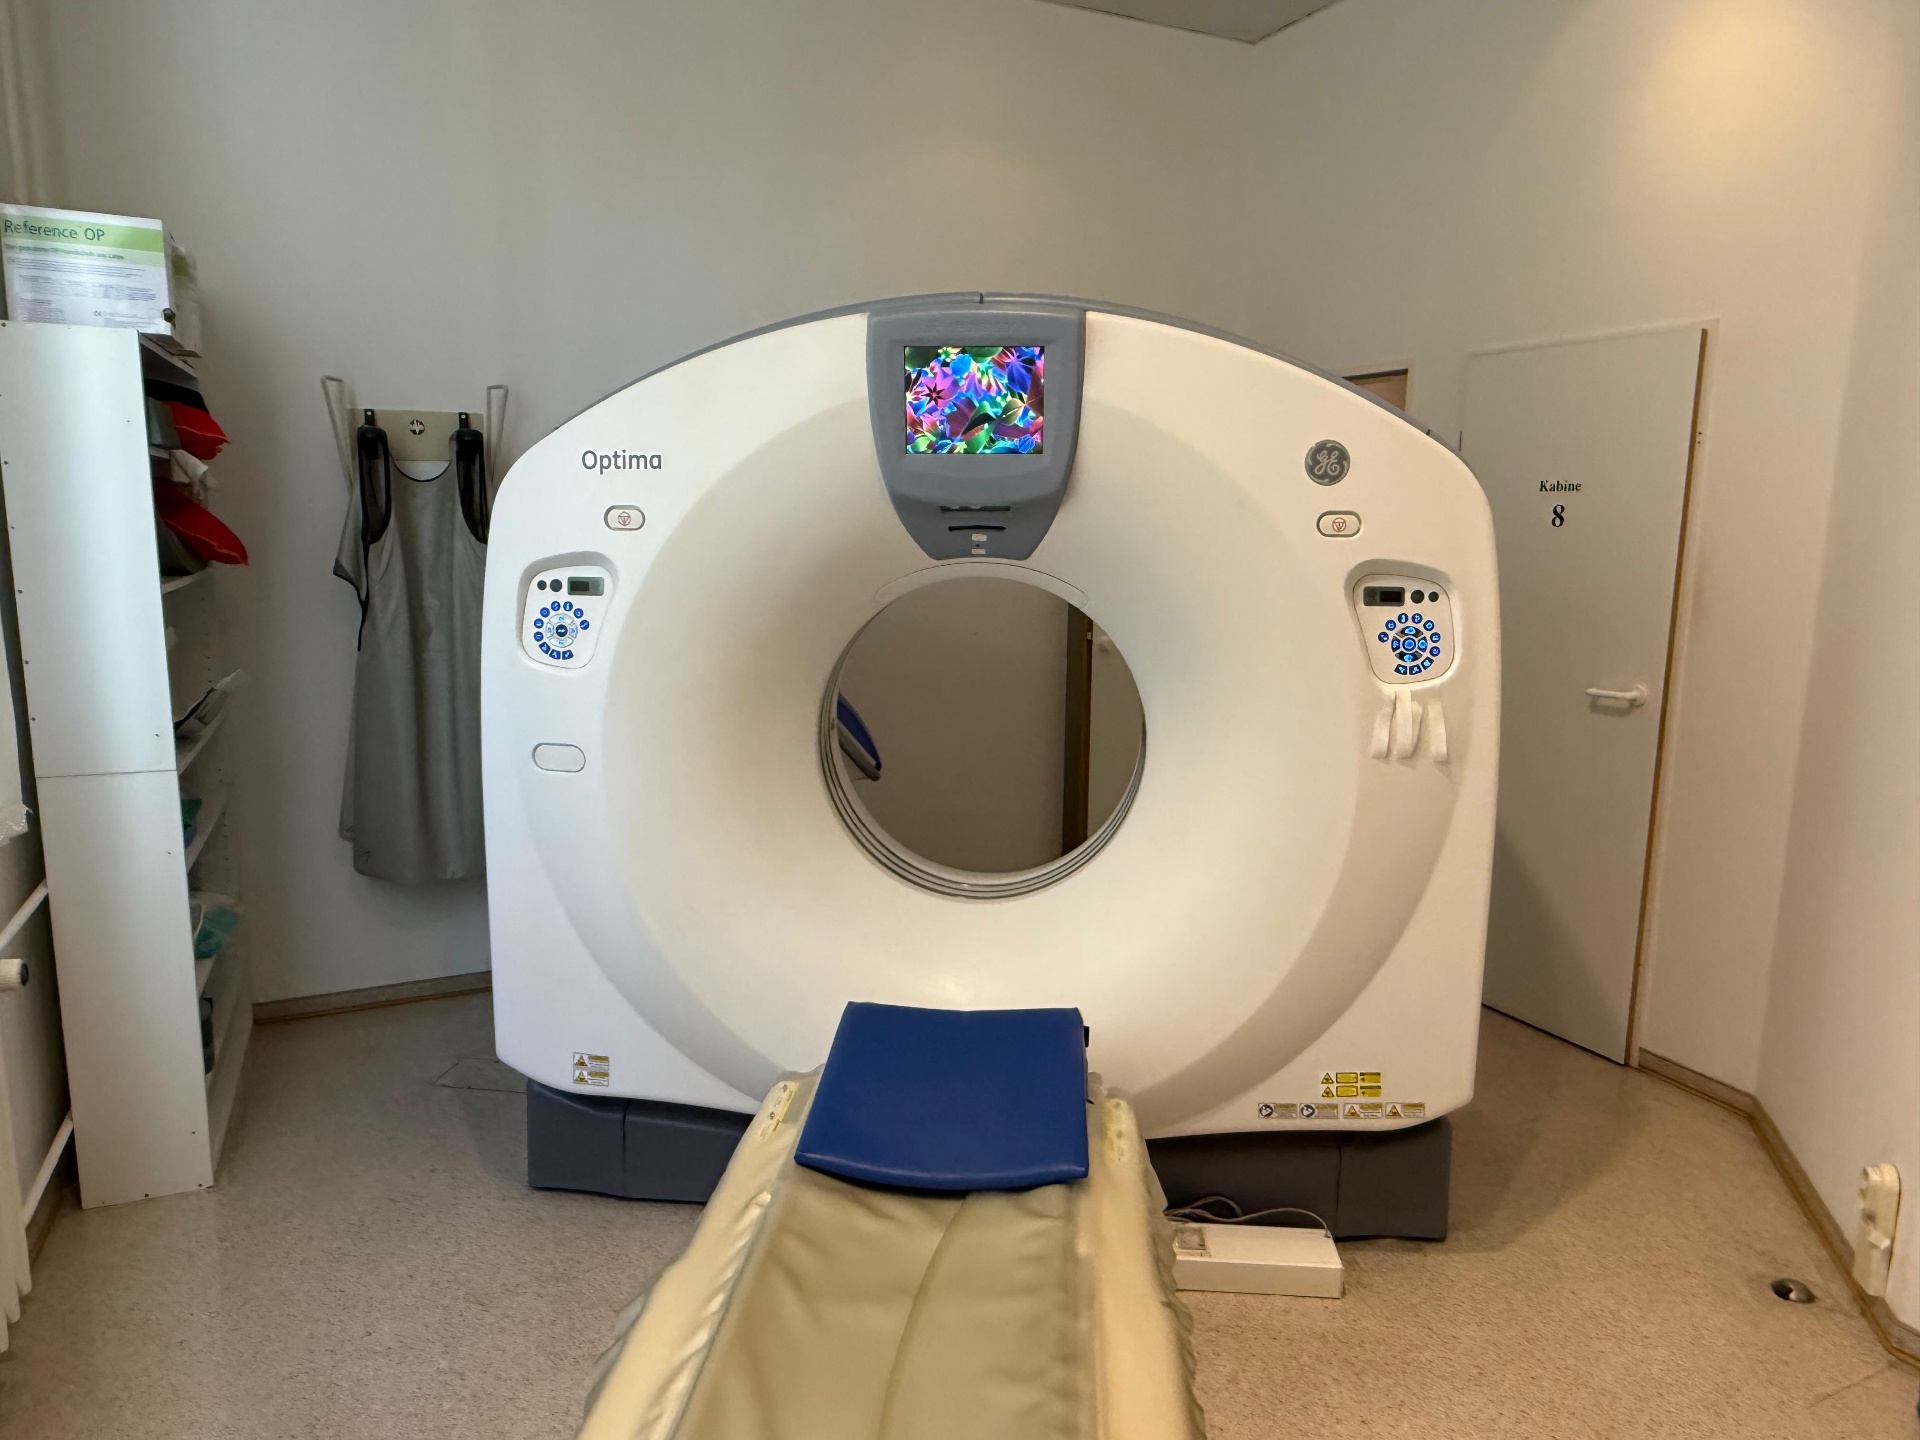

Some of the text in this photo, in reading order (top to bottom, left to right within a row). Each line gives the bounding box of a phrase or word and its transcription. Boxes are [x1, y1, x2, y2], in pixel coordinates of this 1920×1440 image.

[4, 219, 105, 241] Reference OP
[581, 449, 662, 475] Optima
[1539, 480, 1582, 492] Kabine
[1551, 504, 1565, 528] 8
